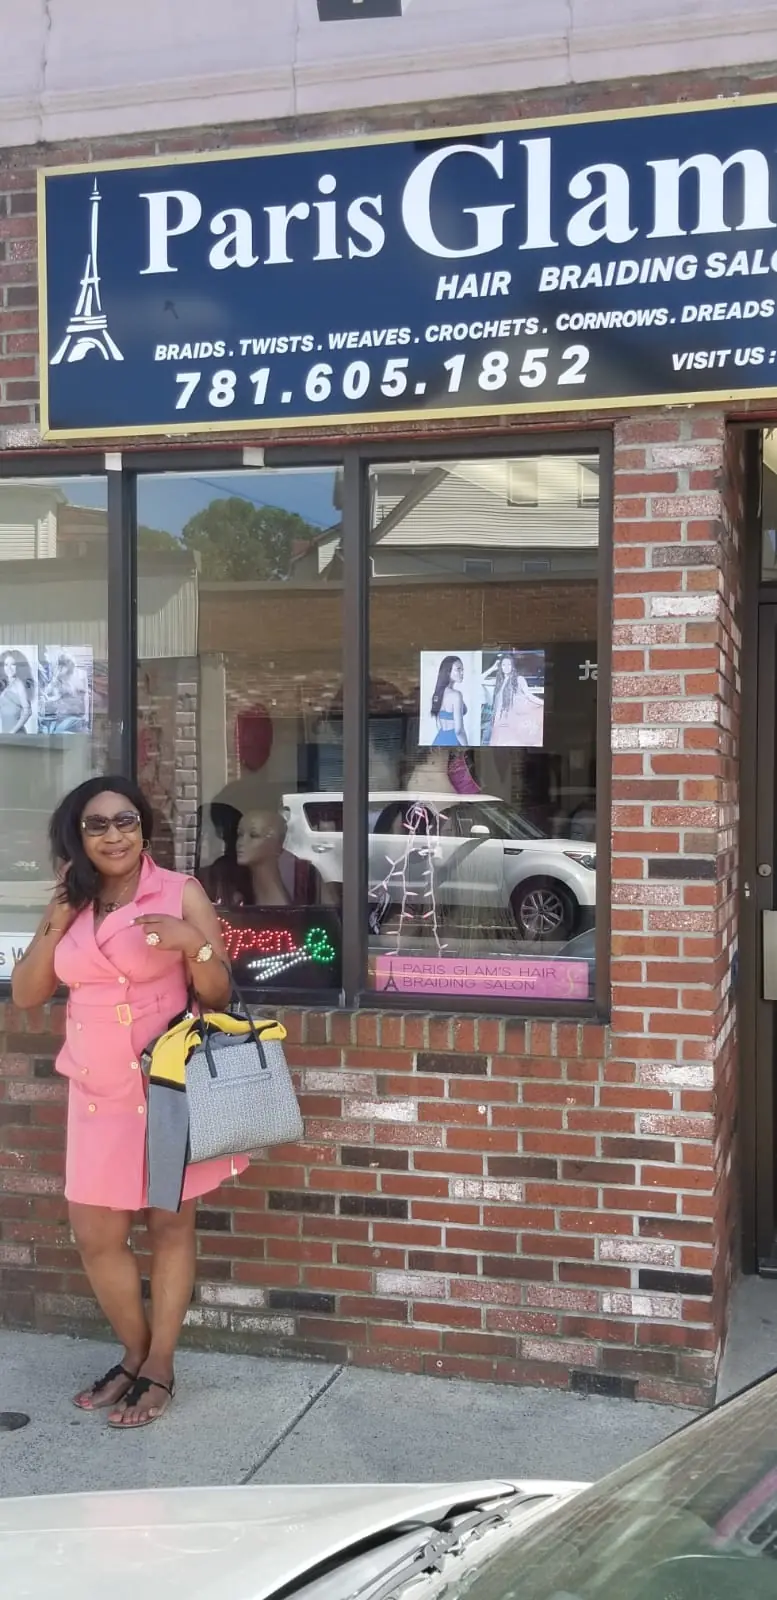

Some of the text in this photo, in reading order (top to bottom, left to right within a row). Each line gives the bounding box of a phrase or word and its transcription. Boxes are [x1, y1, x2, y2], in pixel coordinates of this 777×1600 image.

[139, 136, 777, 275] Paris Glam
[435, 248, 777, 301] HAIR BRAIDING SAL
[680, 299, 776, 323] DREADS
[672, 349, 732, 371] VISIT
[175, 344, 590, 410] 781.605.1852
[402, 963, 557, 978] PARIS GLAM'S HAIR
[403, 976, 536, 991] BRAIDING SALON
